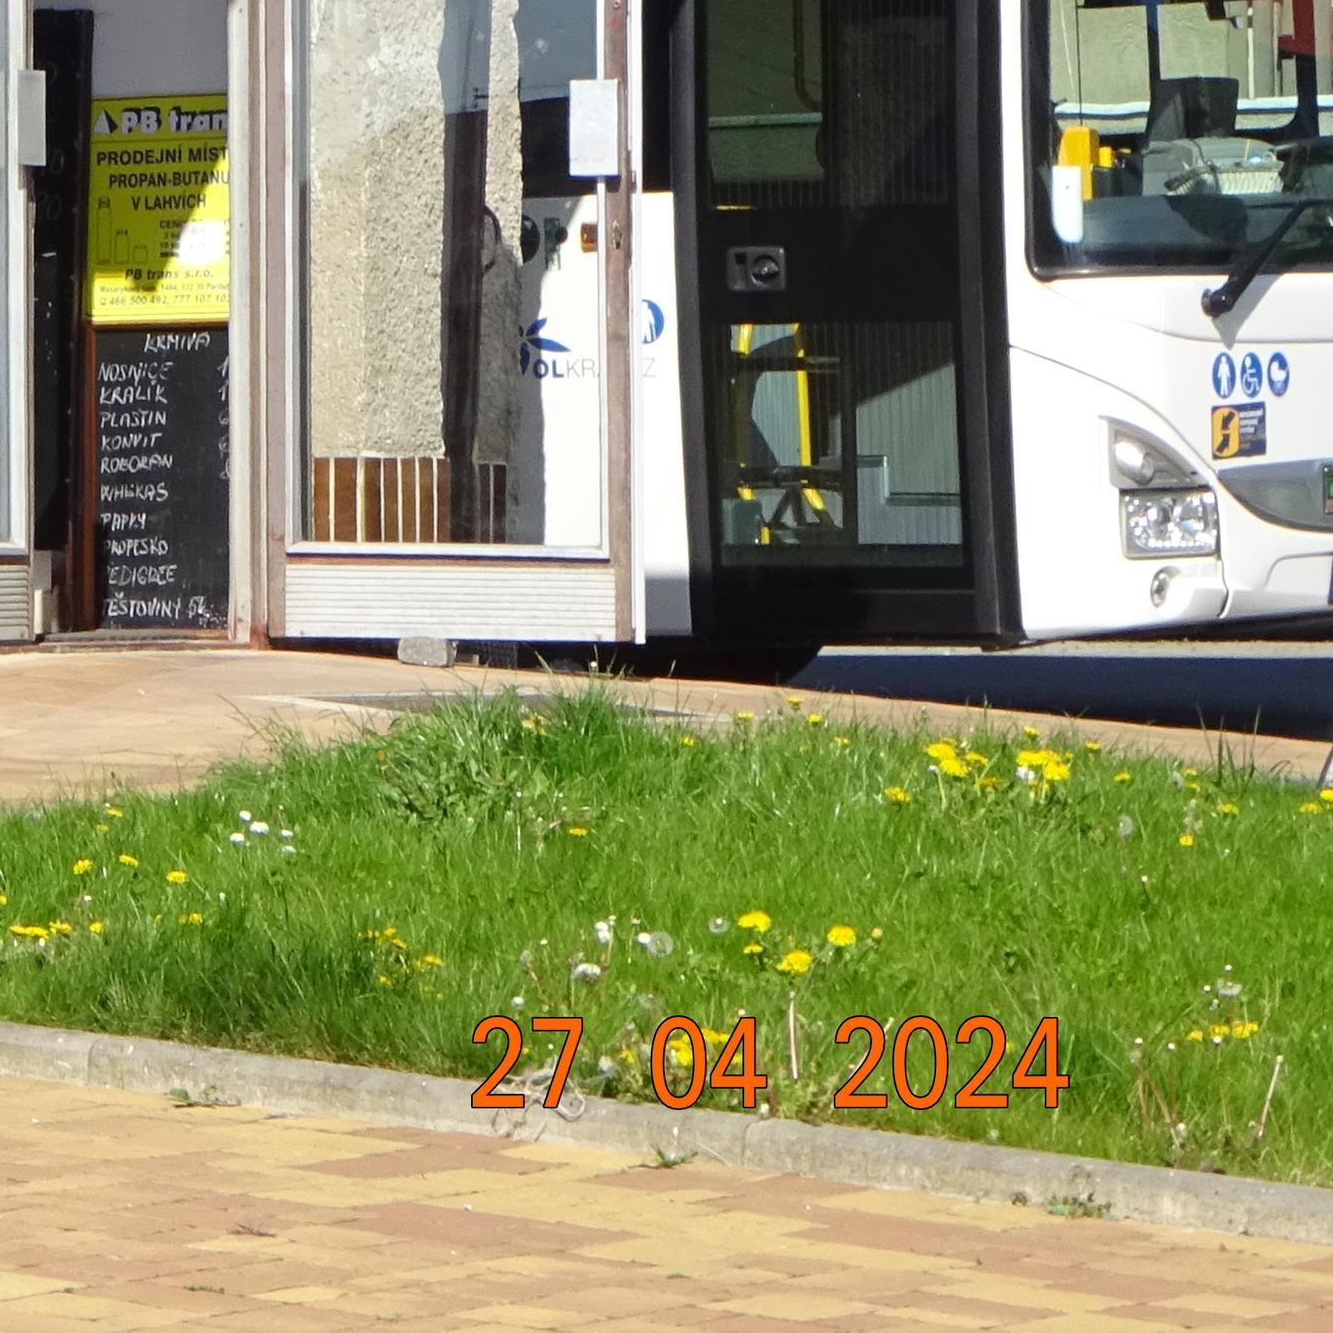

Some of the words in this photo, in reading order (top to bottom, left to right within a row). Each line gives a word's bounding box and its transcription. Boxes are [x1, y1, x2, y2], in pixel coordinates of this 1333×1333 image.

[121, 107, 161, 135] PB
[96, 144, 182, 166] PRODEJNÍ
[132, 196, 141, 211] V
[145, 190, 206, 210] LAHVÍCH
[125, 268, 142, 280] PB
